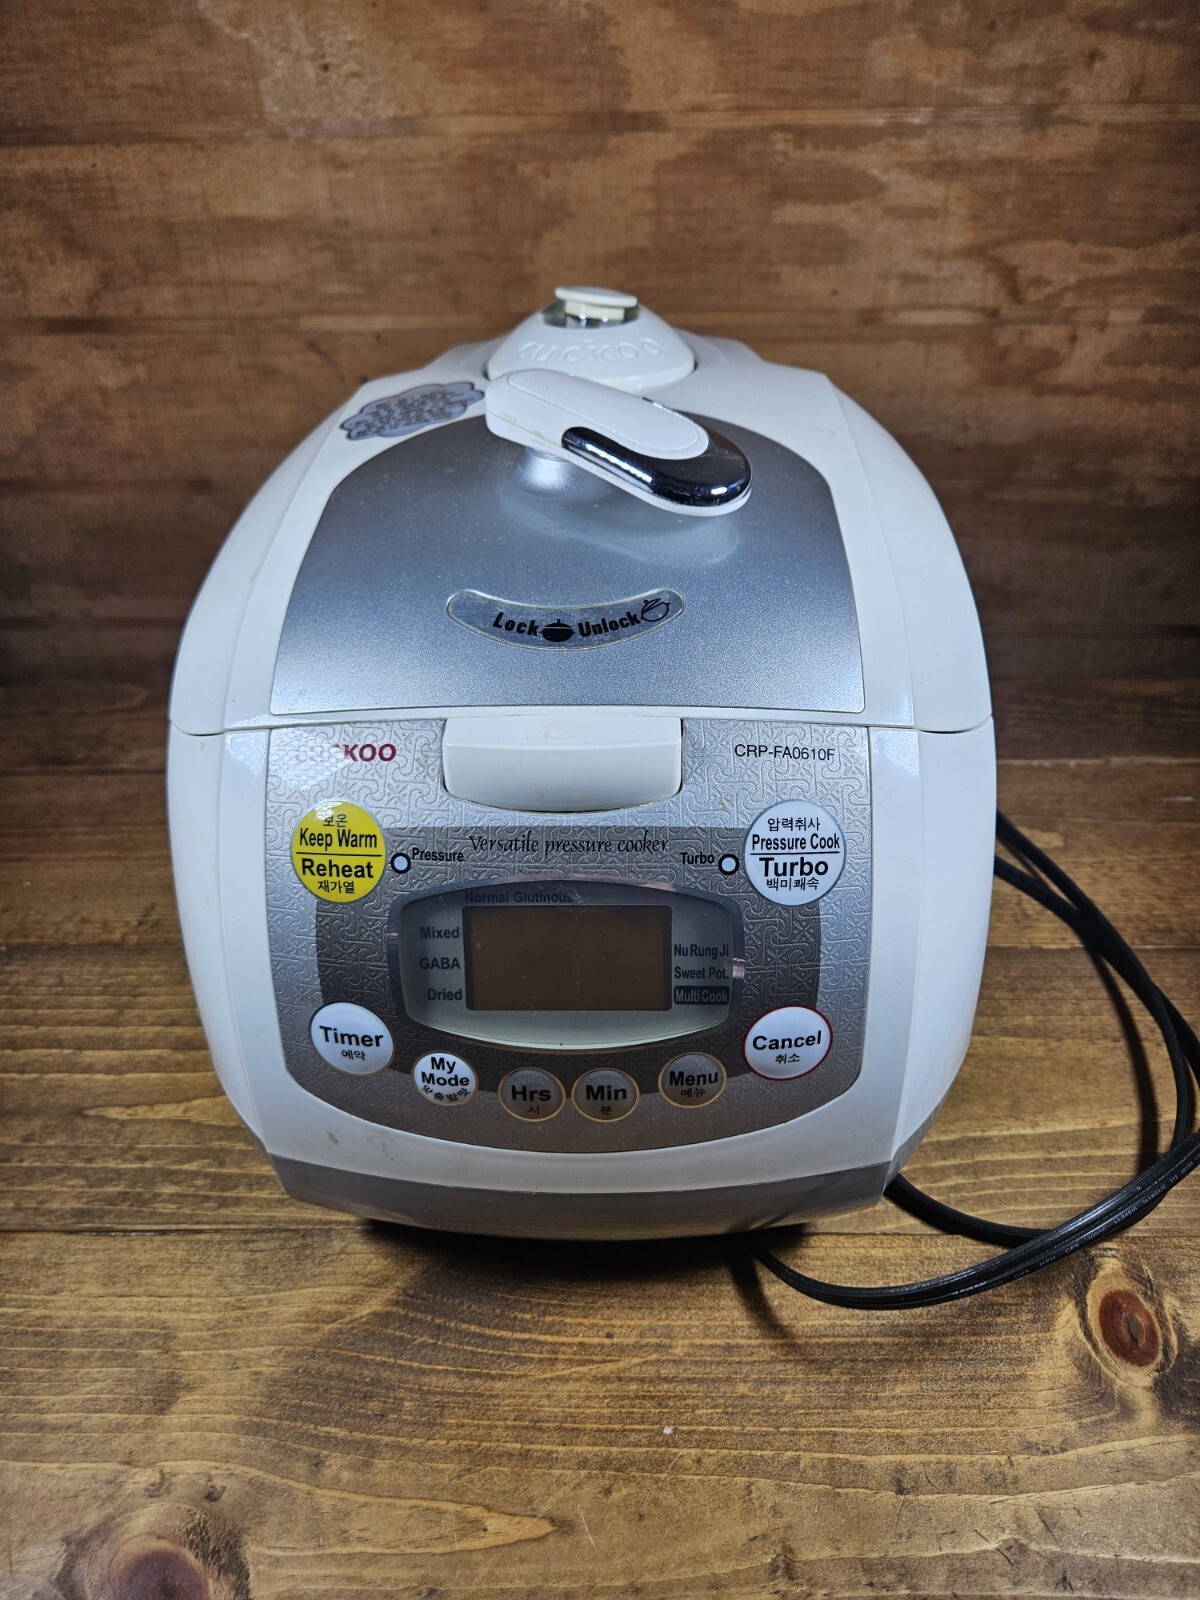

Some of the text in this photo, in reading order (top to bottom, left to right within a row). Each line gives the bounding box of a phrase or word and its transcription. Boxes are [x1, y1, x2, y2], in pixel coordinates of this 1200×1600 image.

[493, 611, 641, 637] Lock Unlock
[735, 743, 836, 761] CRP-FA0610F
[767, 817, 821, 832] 압력취사
[300, 827, 377, 851] Keep Warm
[469, 829, 669, 858] Versatile pressure cooker
[752, 833, 840, 850] Pressure Cook
[412, 847, 464, 862] Pressure
[680, 851, 714, 865] Turbo
[301, 858, 374, 878] Reheat
[759, 857, 829, 877] Turbo
[318, 880, 355, 894] 재가열
[766, 877, 820, 891] 백미쾌속
[465, 891, 574, 904] Normal Glutinous
[420, 926, 460, 939] Mixed
[690, 943, 718, 960] Rung
[719, 943, 729, 957] Ji
[419, 957, 461, 970] GABA
[674, 966, 729, 979] Sweet Pot.
[427, 988, 463, 1001] Dried
[675, 988, 729, 1003] Multi Cook
[319, 1025, 384, 1048] Timer
[753, 1030, 822, 1051] Cancel
[341, 1049, 366, 1061] 예약
[775, 1053, 800, 1064] 취소
[430, 1056, 456, 1074] My
[421, 1071, 470, 1087] Mode
[669, 1070, 718, 1086] Menu
[511, 1084, 552, 1102] Hrs
[586, 1084, 627, 1101] Min
[680, 1088, 706, 1098] 메뉴
[528, 1106, 540, 1115] 시
[600, 1105, 613, 1115] 분
